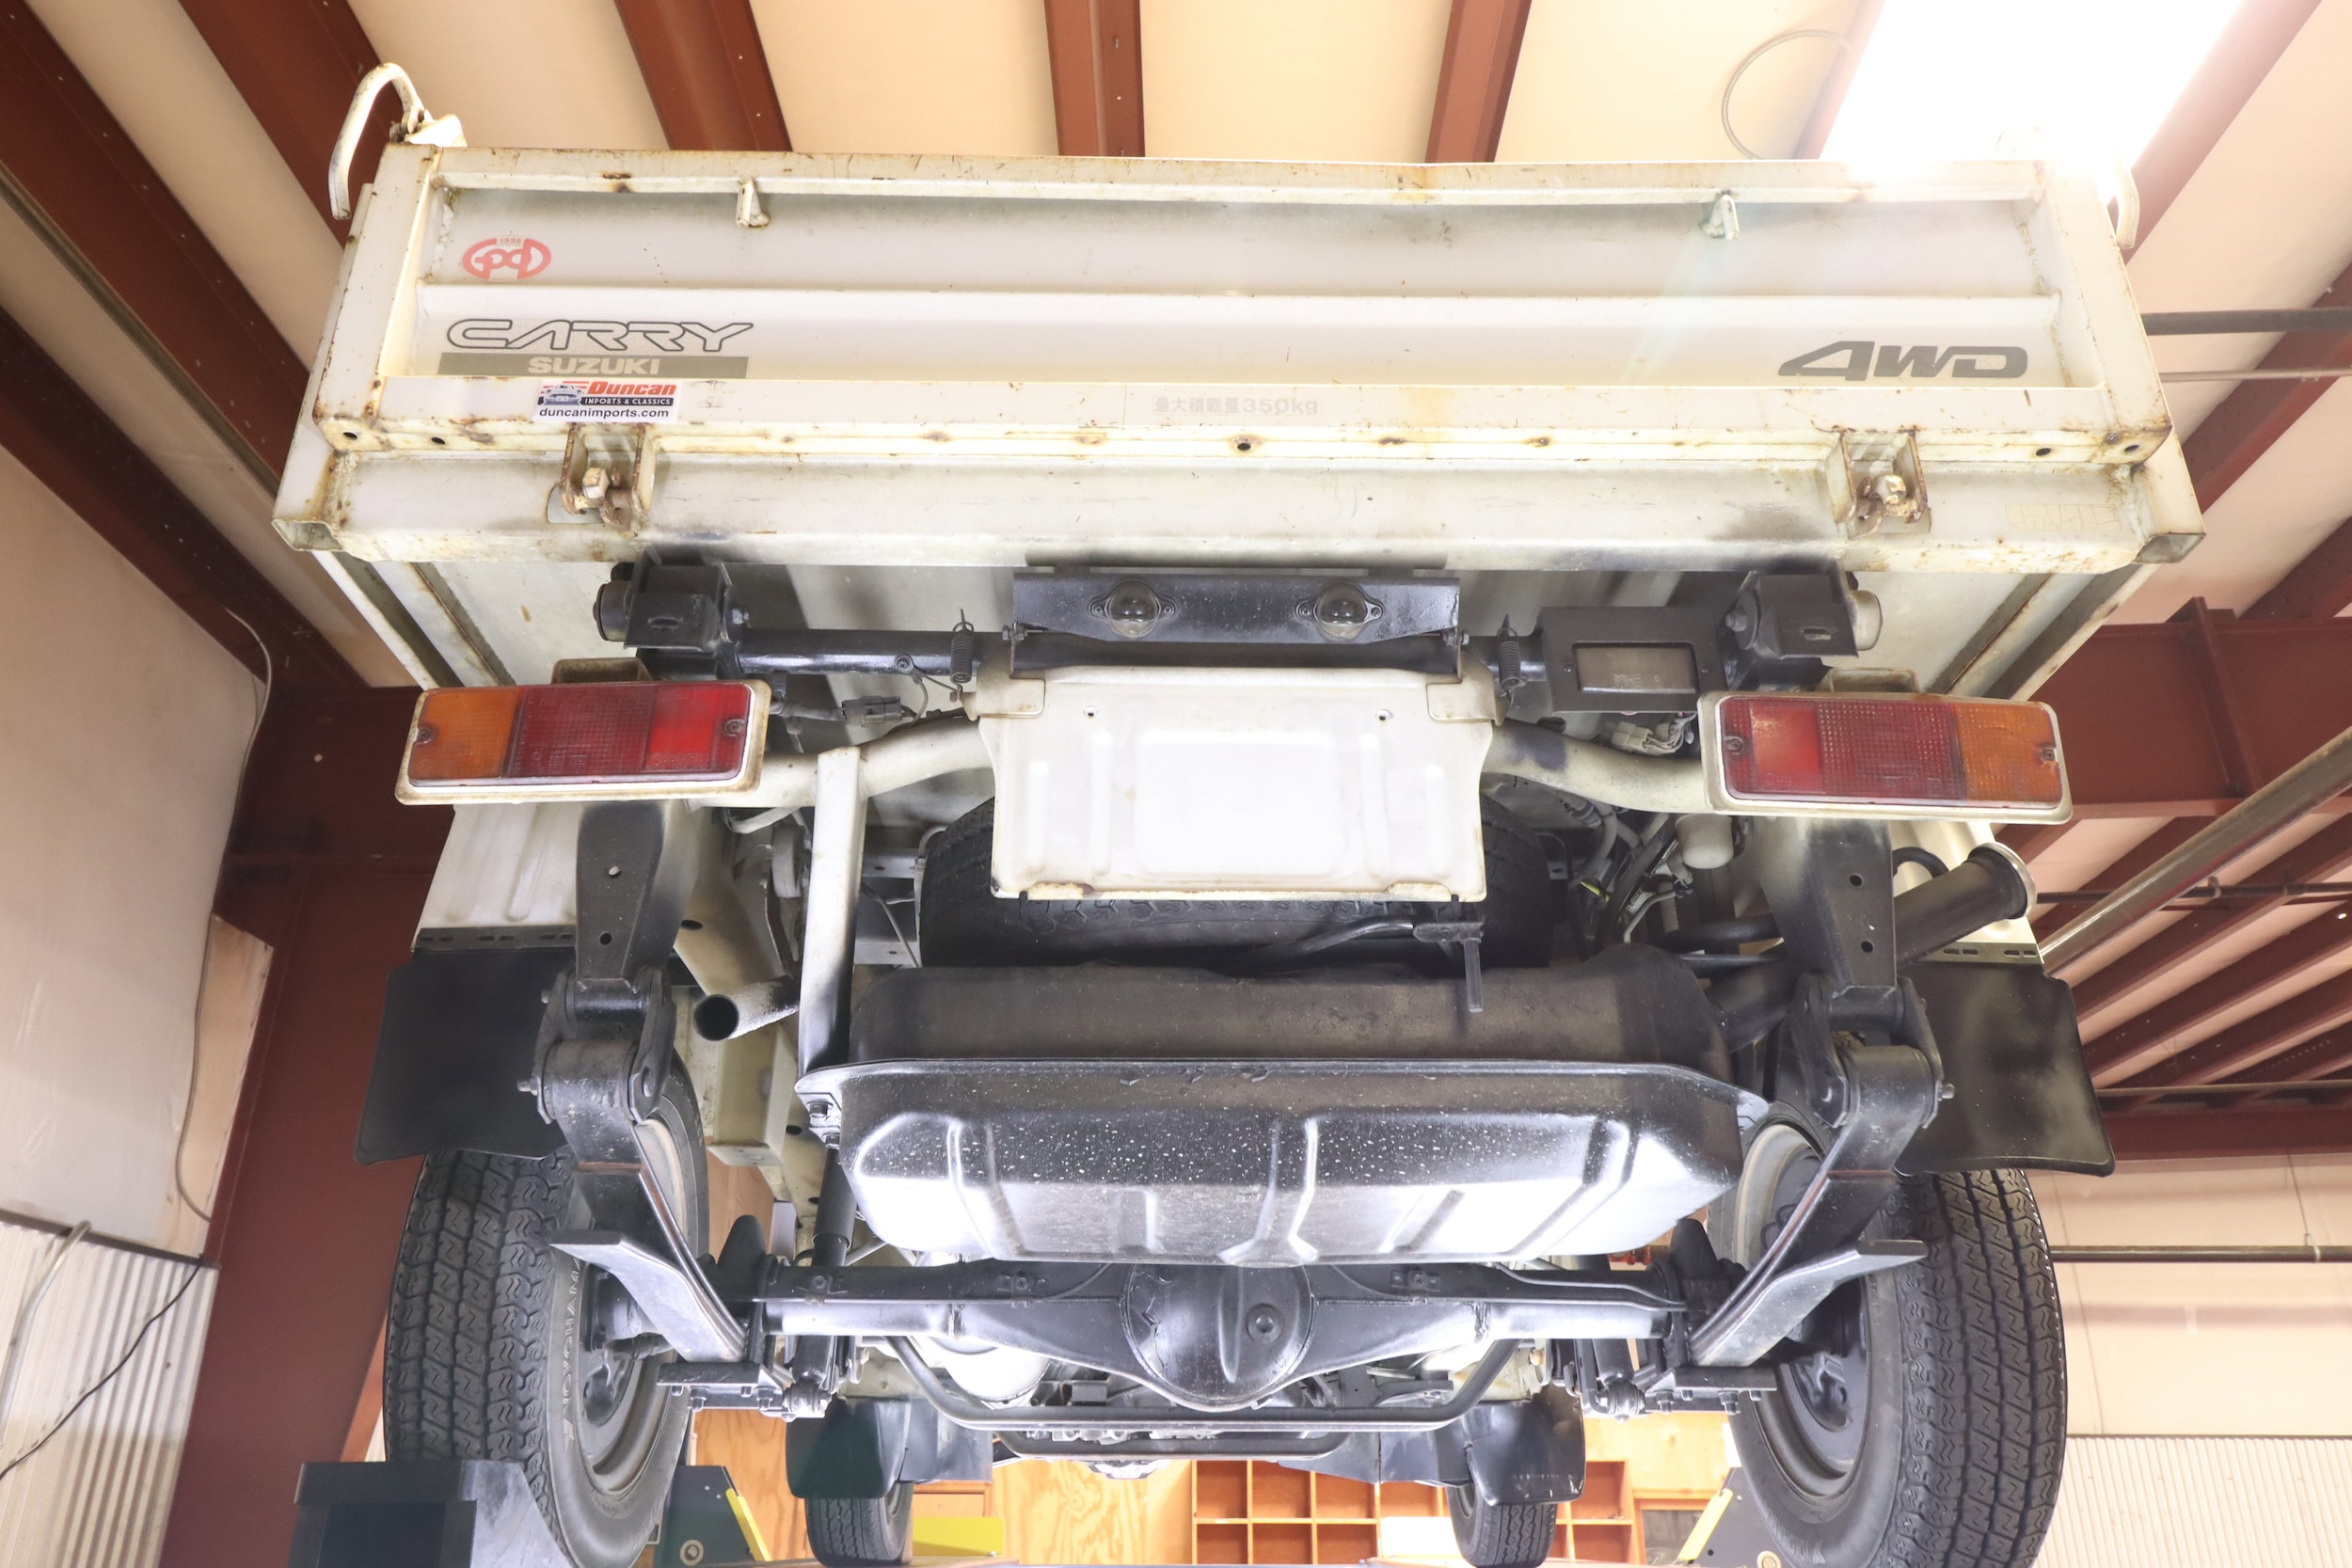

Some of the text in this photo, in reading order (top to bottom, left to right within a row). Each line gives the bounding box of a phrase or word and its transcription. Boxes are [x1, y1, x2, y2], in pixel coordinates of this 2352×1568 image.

[447, 319, 754, 352] CARRY
[529, 357, 660, 375] SUZUKI
[1778, 341, 2027, 381] 4WD
[587, 381, 677, 395] Duncan
[539, 407, 669, 419] duncanimports.com
